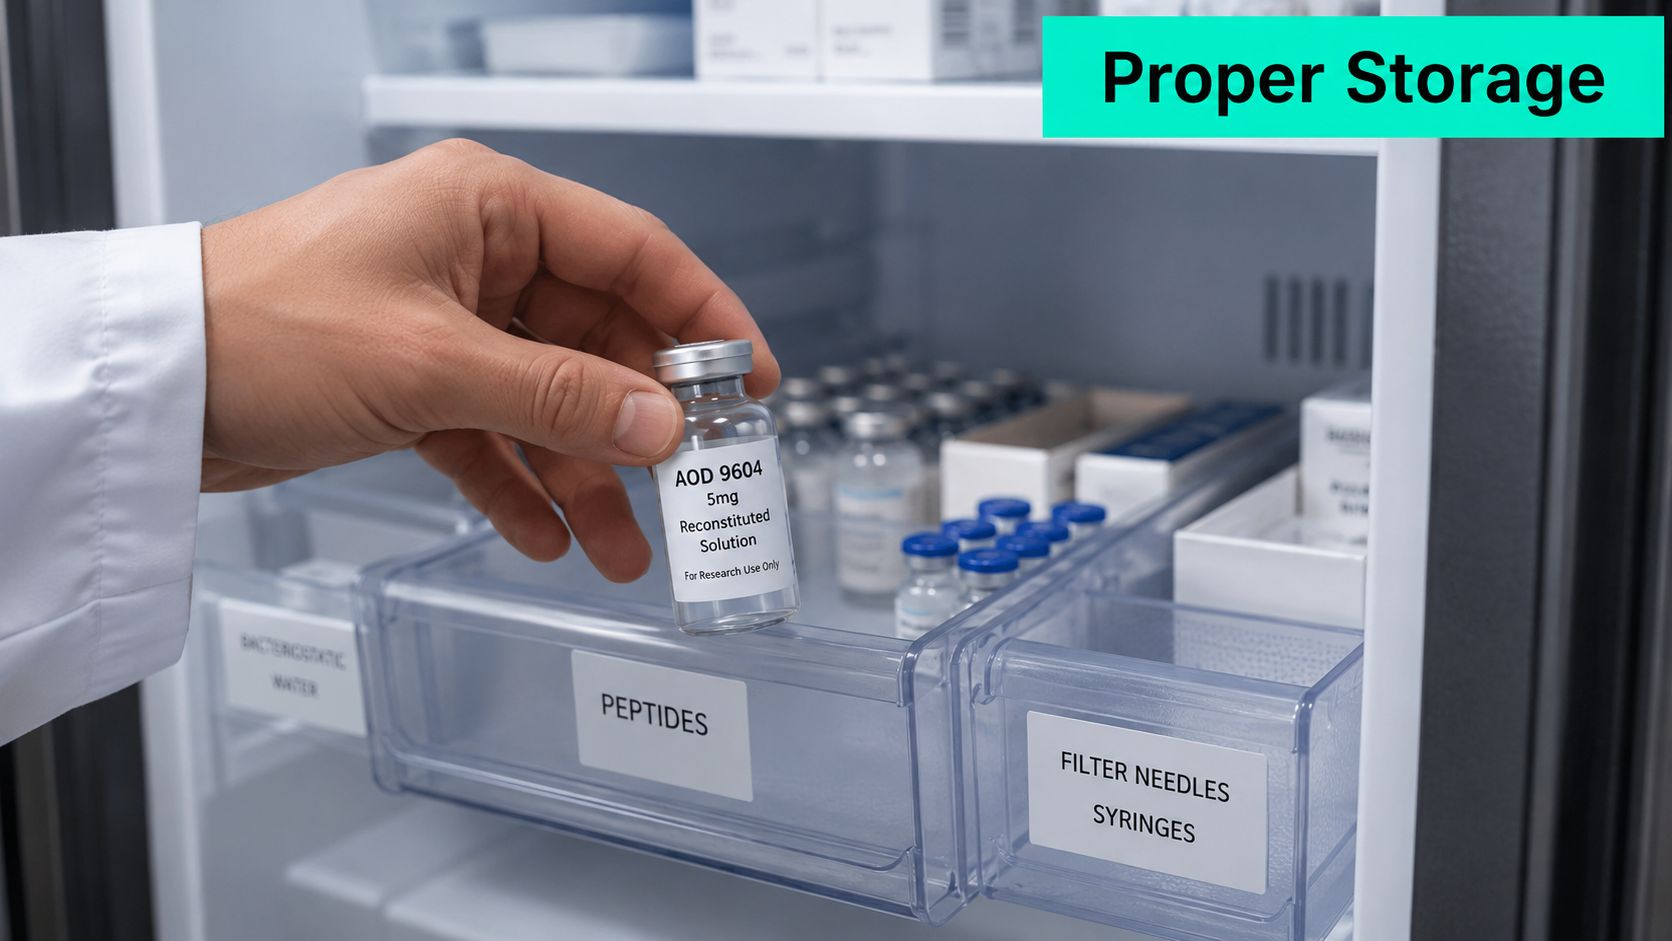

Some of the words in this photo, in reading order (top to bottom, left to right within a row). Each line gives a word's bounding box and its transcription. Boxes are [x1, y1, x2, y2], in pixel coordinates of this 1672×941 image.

[675, 467, 714, 487] AOD
[719, 459, 763, 482] 9604
[707, 491, 739, 507] 5mg
[680, 508, 771, 533] Reconstituted
[700, 535, 757, 553] Solution
[684, 571, 698, 581] For
[699, 567, 742, 580] Research
[743, 565, 761, 575] Use
[762, 560, 780, 571] Only
[272, 674, 319, 698] WATER
[601, 693, 709, 736] PEPTIDES
[1061, 751, 1128, 782] FILTER
[1135, 765, 1230, 803] NEEDLES
[1093, 804, 1196, 844] SYRINGES
